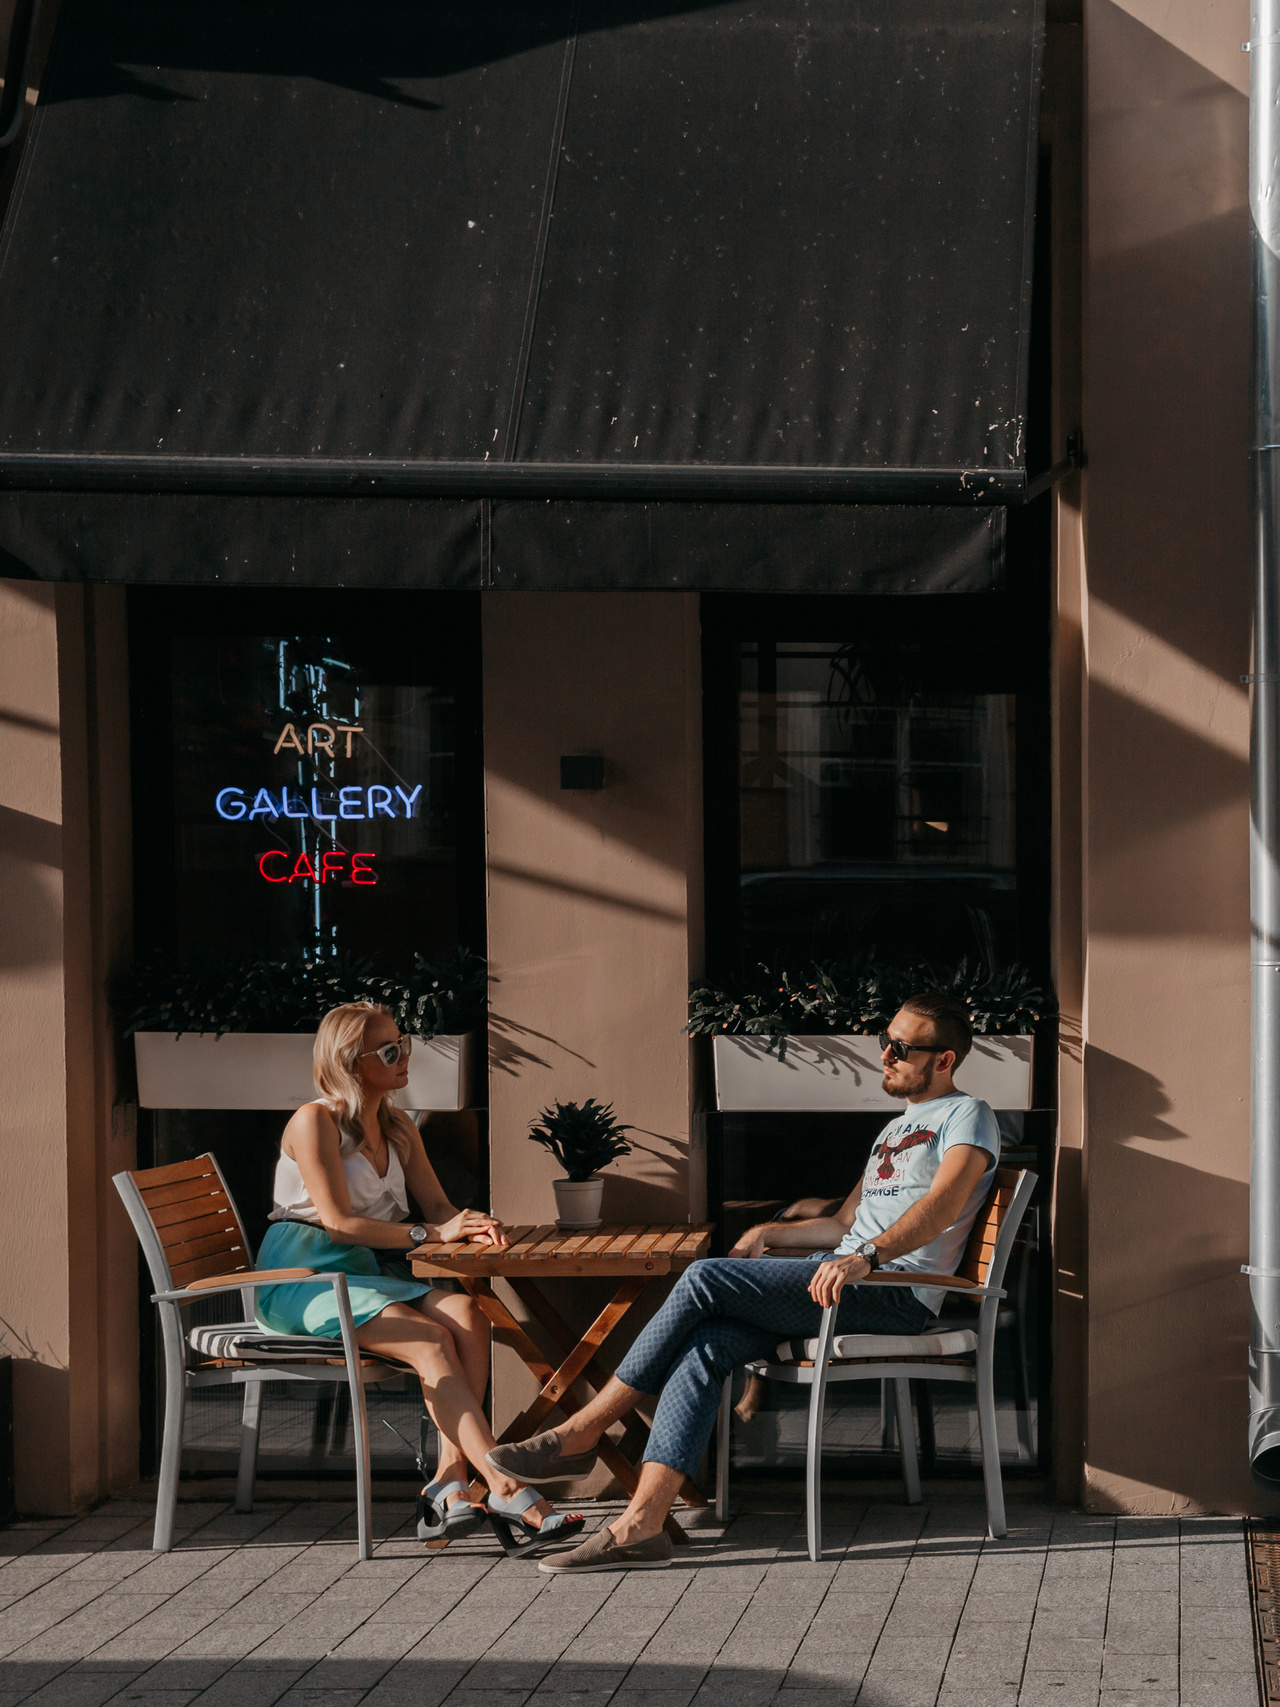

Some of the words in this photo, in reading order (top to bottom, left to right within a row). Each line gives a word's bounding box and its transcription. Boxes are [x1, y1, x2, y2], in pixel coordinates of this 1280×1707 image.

[275, 723, 364, 758] ART
[215, 784, 423, 822] GALLERY
[259, 850, 377, 885] CAFE
